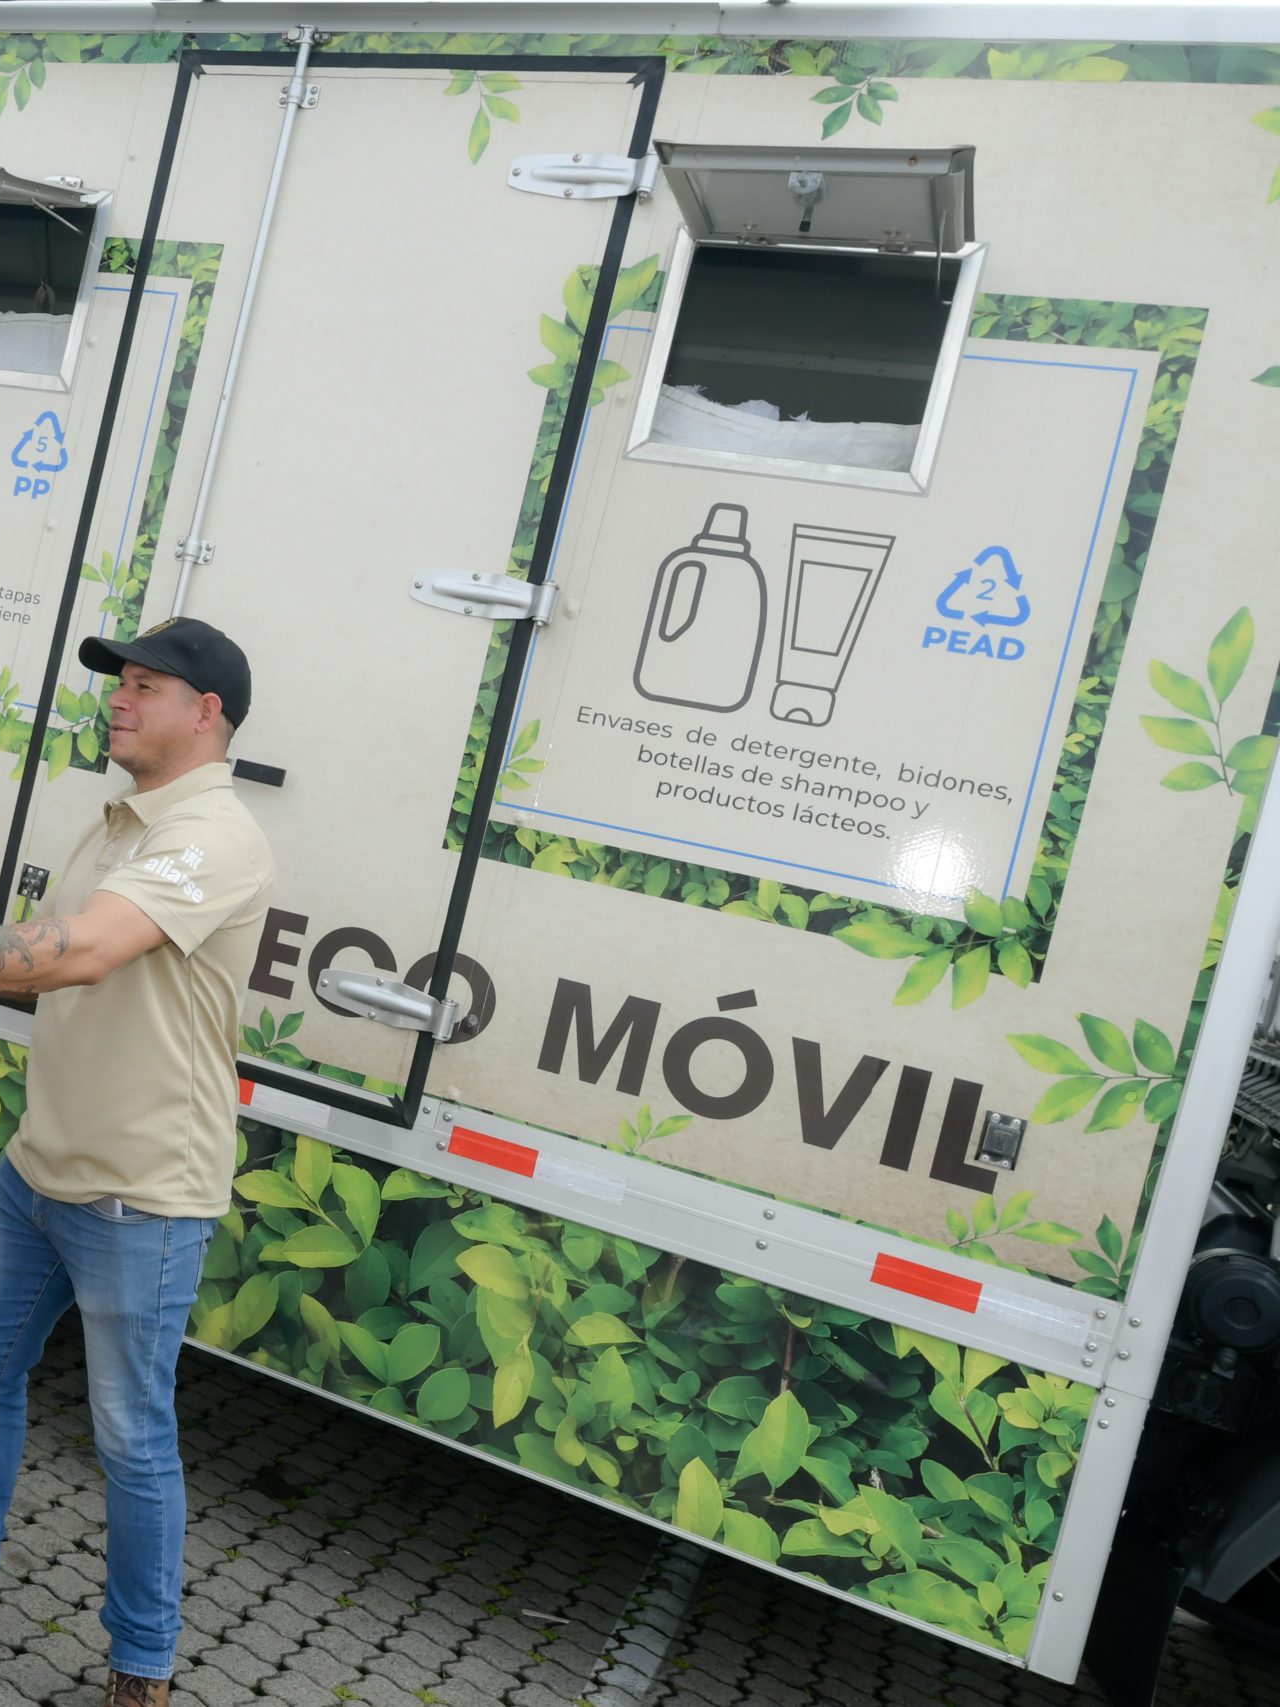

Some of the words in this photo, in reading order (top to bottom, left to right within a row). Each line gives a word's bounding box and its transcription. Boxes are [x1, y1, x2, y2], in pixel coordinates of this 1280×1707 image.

[35, 435, 48, 454] 5
[13, 475, 51, 500] PP
[0, 586, 40, 605] tapas
[976, 578, 997, 601] 2
[921, 625, 1026, 662] PEAD
[576, 704, 673, 739] Envases
[686, 724, 717, 747] de
[730, 734, 883, 782] detergente,
[897, 762, 1014, 804] bidones,
[636, 743, 735, 780] botellas
[741, 764, 774, 787] de
[780, 773, 907, 814] shampoo
[909, 797, 931, 820] y
[655, 777, 786, 821] productos
[791, 801, 892, 841] lácteos.
[144, 856, 204, 904] aliarse
[247, 906, 497, 1046] ECO
[537, 978, 1000, 1195] MÓVIL
